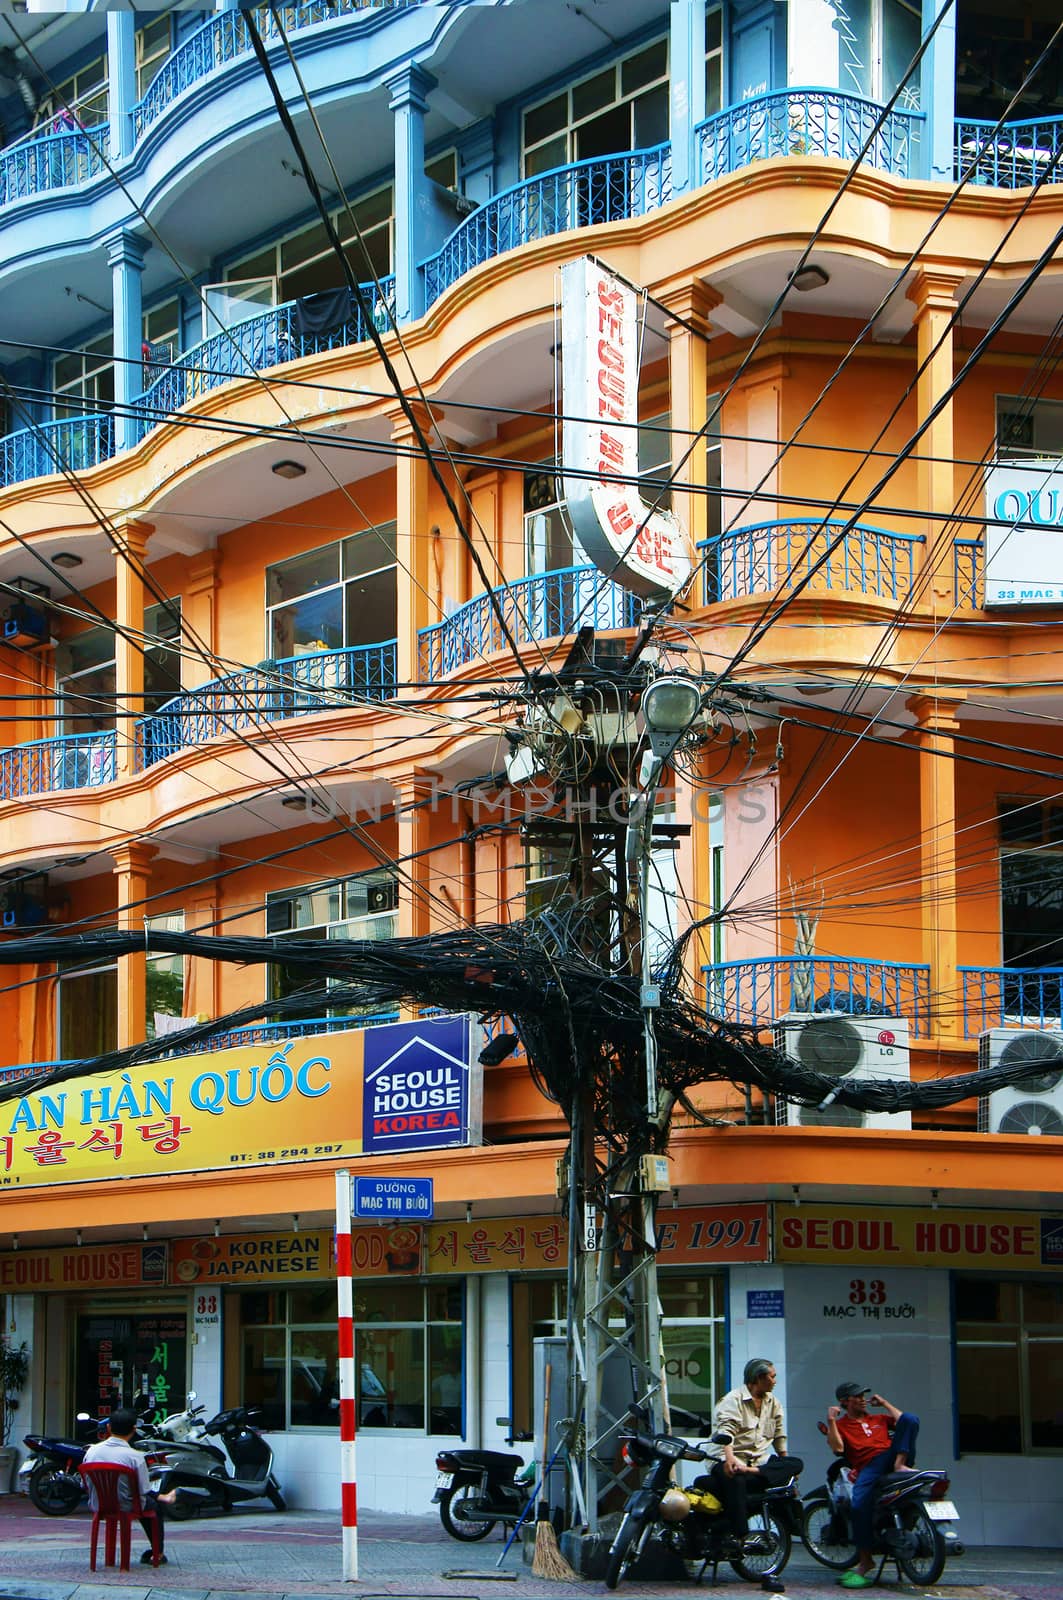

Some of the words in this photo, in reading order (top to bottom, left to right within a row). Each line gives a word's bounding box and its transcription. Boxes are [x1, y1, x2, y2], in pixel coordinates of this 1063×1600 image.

[597, 279, 625, 423] SEOUL
[997, 590, 1016, 599] 33
[879, 1048, 894, 1056] LG
[80, 1072, 175, 1125] HÀN
[189, 1042, 332, 1115] QUỐC
[375, 1067, 459, 1093] SEOUL
[373, 1086, 461, 1113] HOUSE
[373, 1111, 460, 1134] KOREA
[258, 1151, 275, 1160] 38
[376, 1181, 416, 1193] ĐƯỜNG
[361, 1196, 383, 1211] MẠC
[687, 1217, 763, 1249] 1991
[781, 1217, 900, 1252] SEOUL
[914, 1222, 1037, 1256] HOUSE
[229, 1237, 320, 1257] KOREAN
[430, 1223, 566, 1267] 서울식당
[62, 1251, 137, 1282] HOUSE
[207, 1256, 320, 1276] JAPANESE
[849, 1278, 887, 1305] 33
[197, 1295, 217, 1314] 33
[823, 1306, 855, 1319] MẠC
